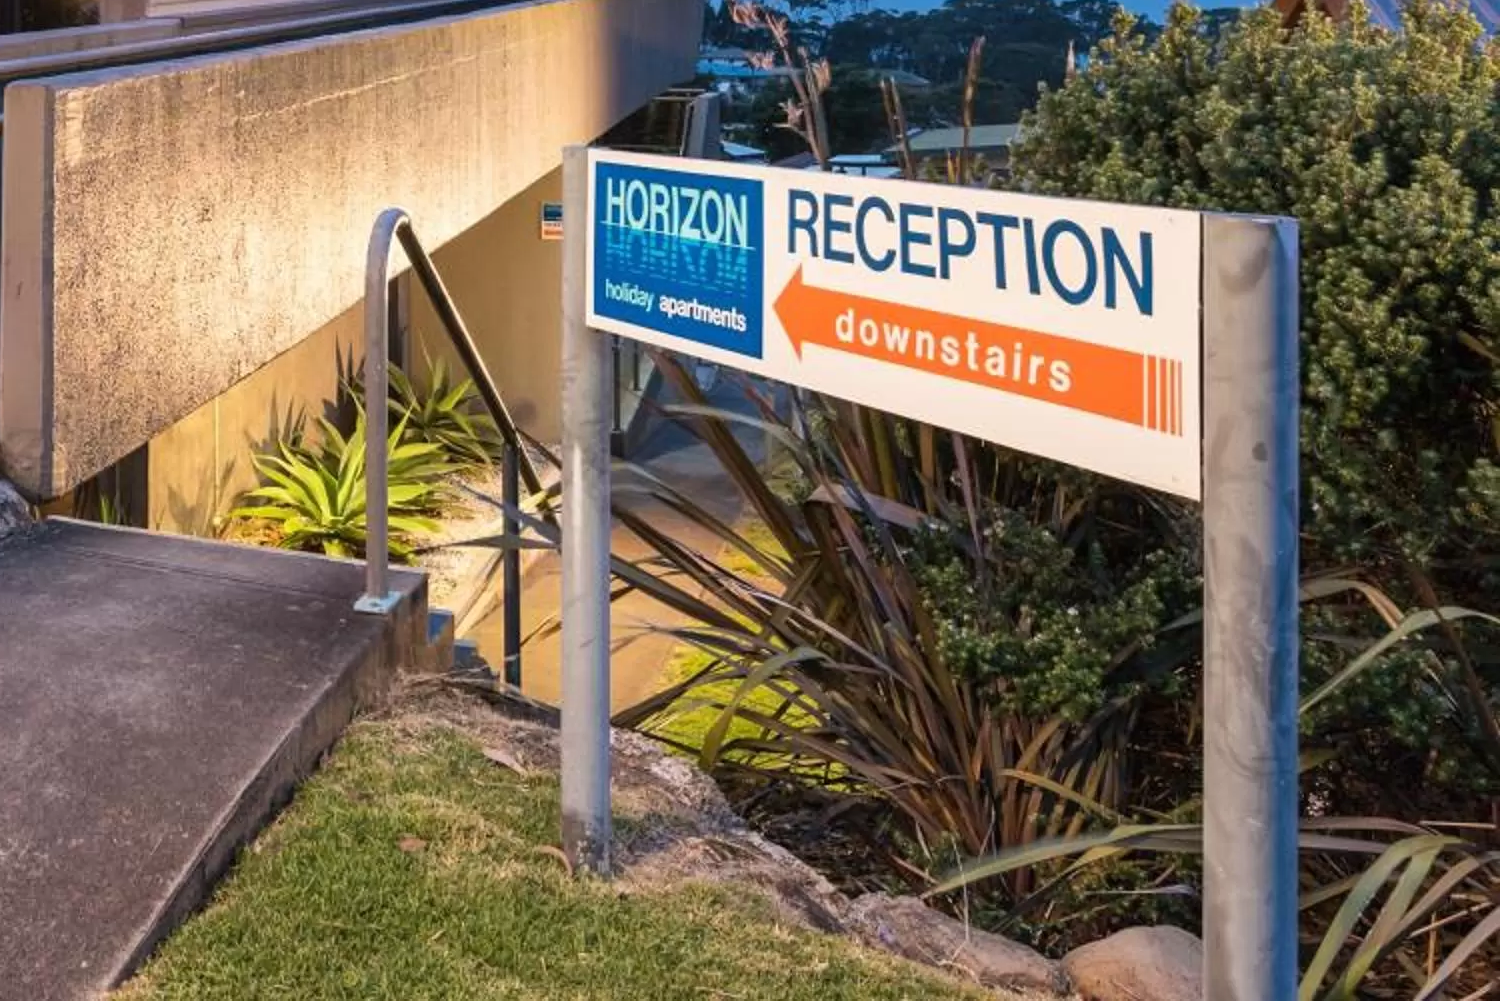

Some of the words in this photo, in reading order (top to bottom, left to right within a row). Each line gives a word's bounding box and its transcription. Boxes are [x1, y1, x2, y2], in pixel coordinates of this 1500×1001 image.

[607, 177, 747, 248] HORIZON
[788, 189, 1153, 316] RECEPTION
[605, 279, 655, 312] holiday
[659, 294, 748, 332] apartments
[835, 308, 1072, 393] downstairs
